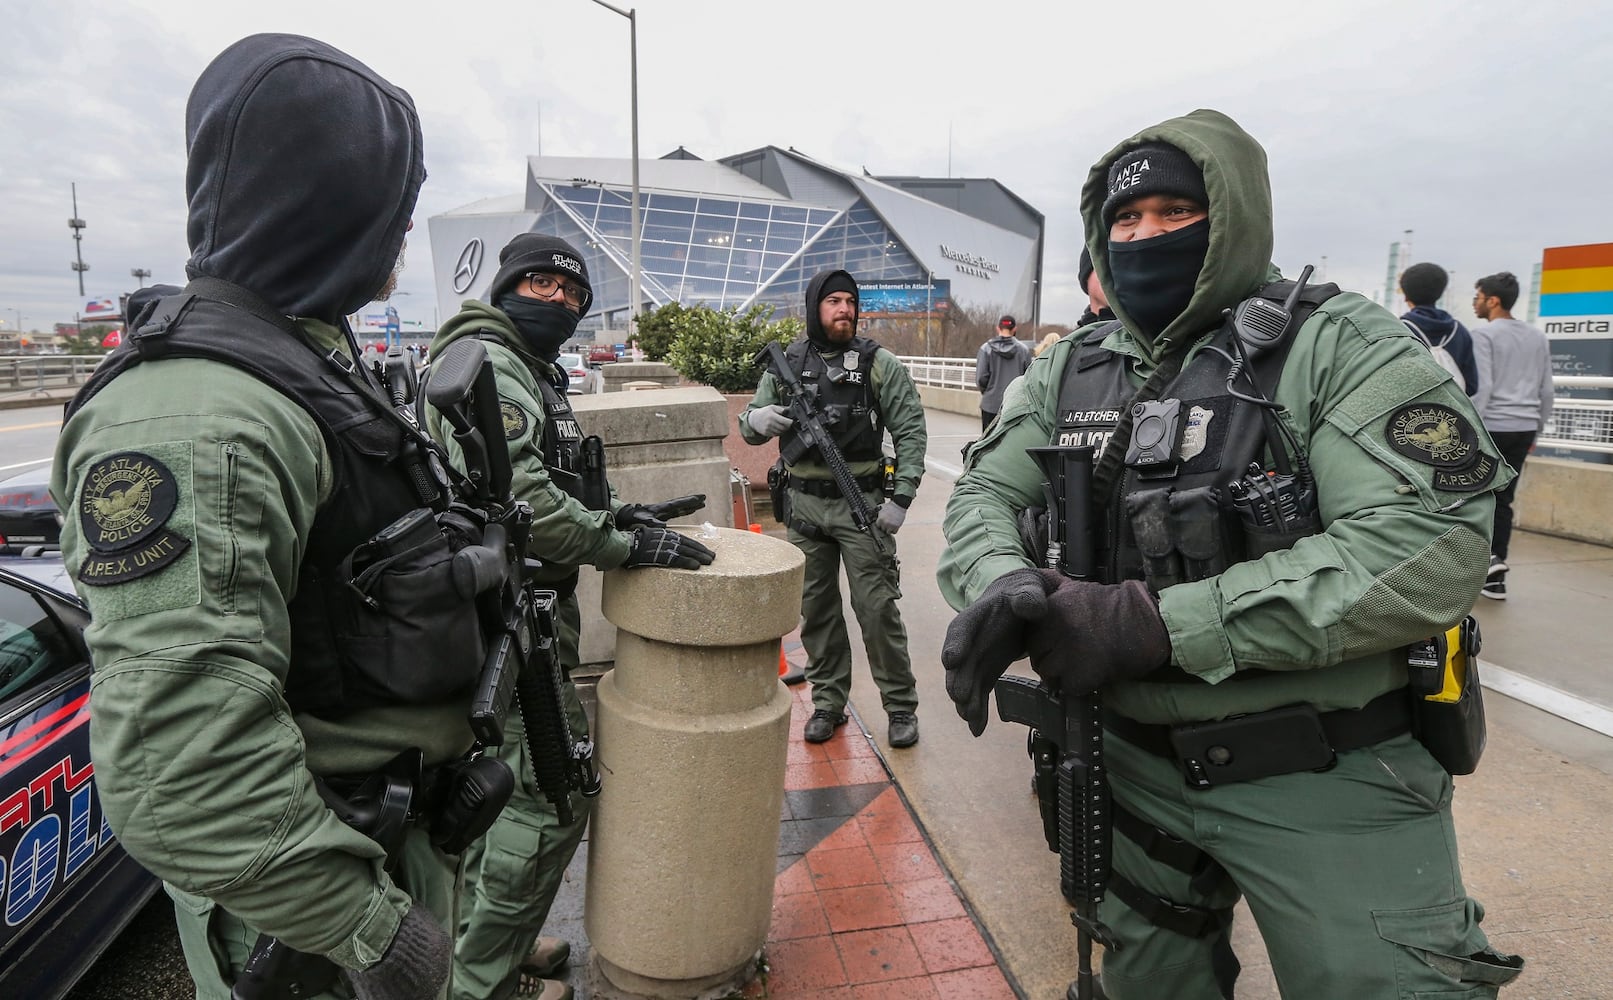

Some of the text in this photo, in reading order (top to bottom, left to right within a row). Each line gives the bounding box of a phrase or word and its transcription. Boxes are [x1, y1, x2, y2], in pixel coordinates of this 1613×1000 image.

[1115, 159, 1151, 184] ANTA
[552, 254, 582, 270] ATLANTA
[554, 260, 581, 275] POLICE
[1545, 320, 1609, 333] marta
[1396, 415, 1410, 428] OF
[1408, 408, 1458, 425] ATLANTA
[1393, 429, 1409, 446] CITY
[1431, 442, 1471, 461] POLICE
[1474, 456, 1492, 480] UNIT
[83, 459, 163, 514] CITY OF ATLANTA
[99, 513, 154, 542] POLICE
[134, 537, 174, 567] UNIT
[0, 754, 95, 836] ATL
